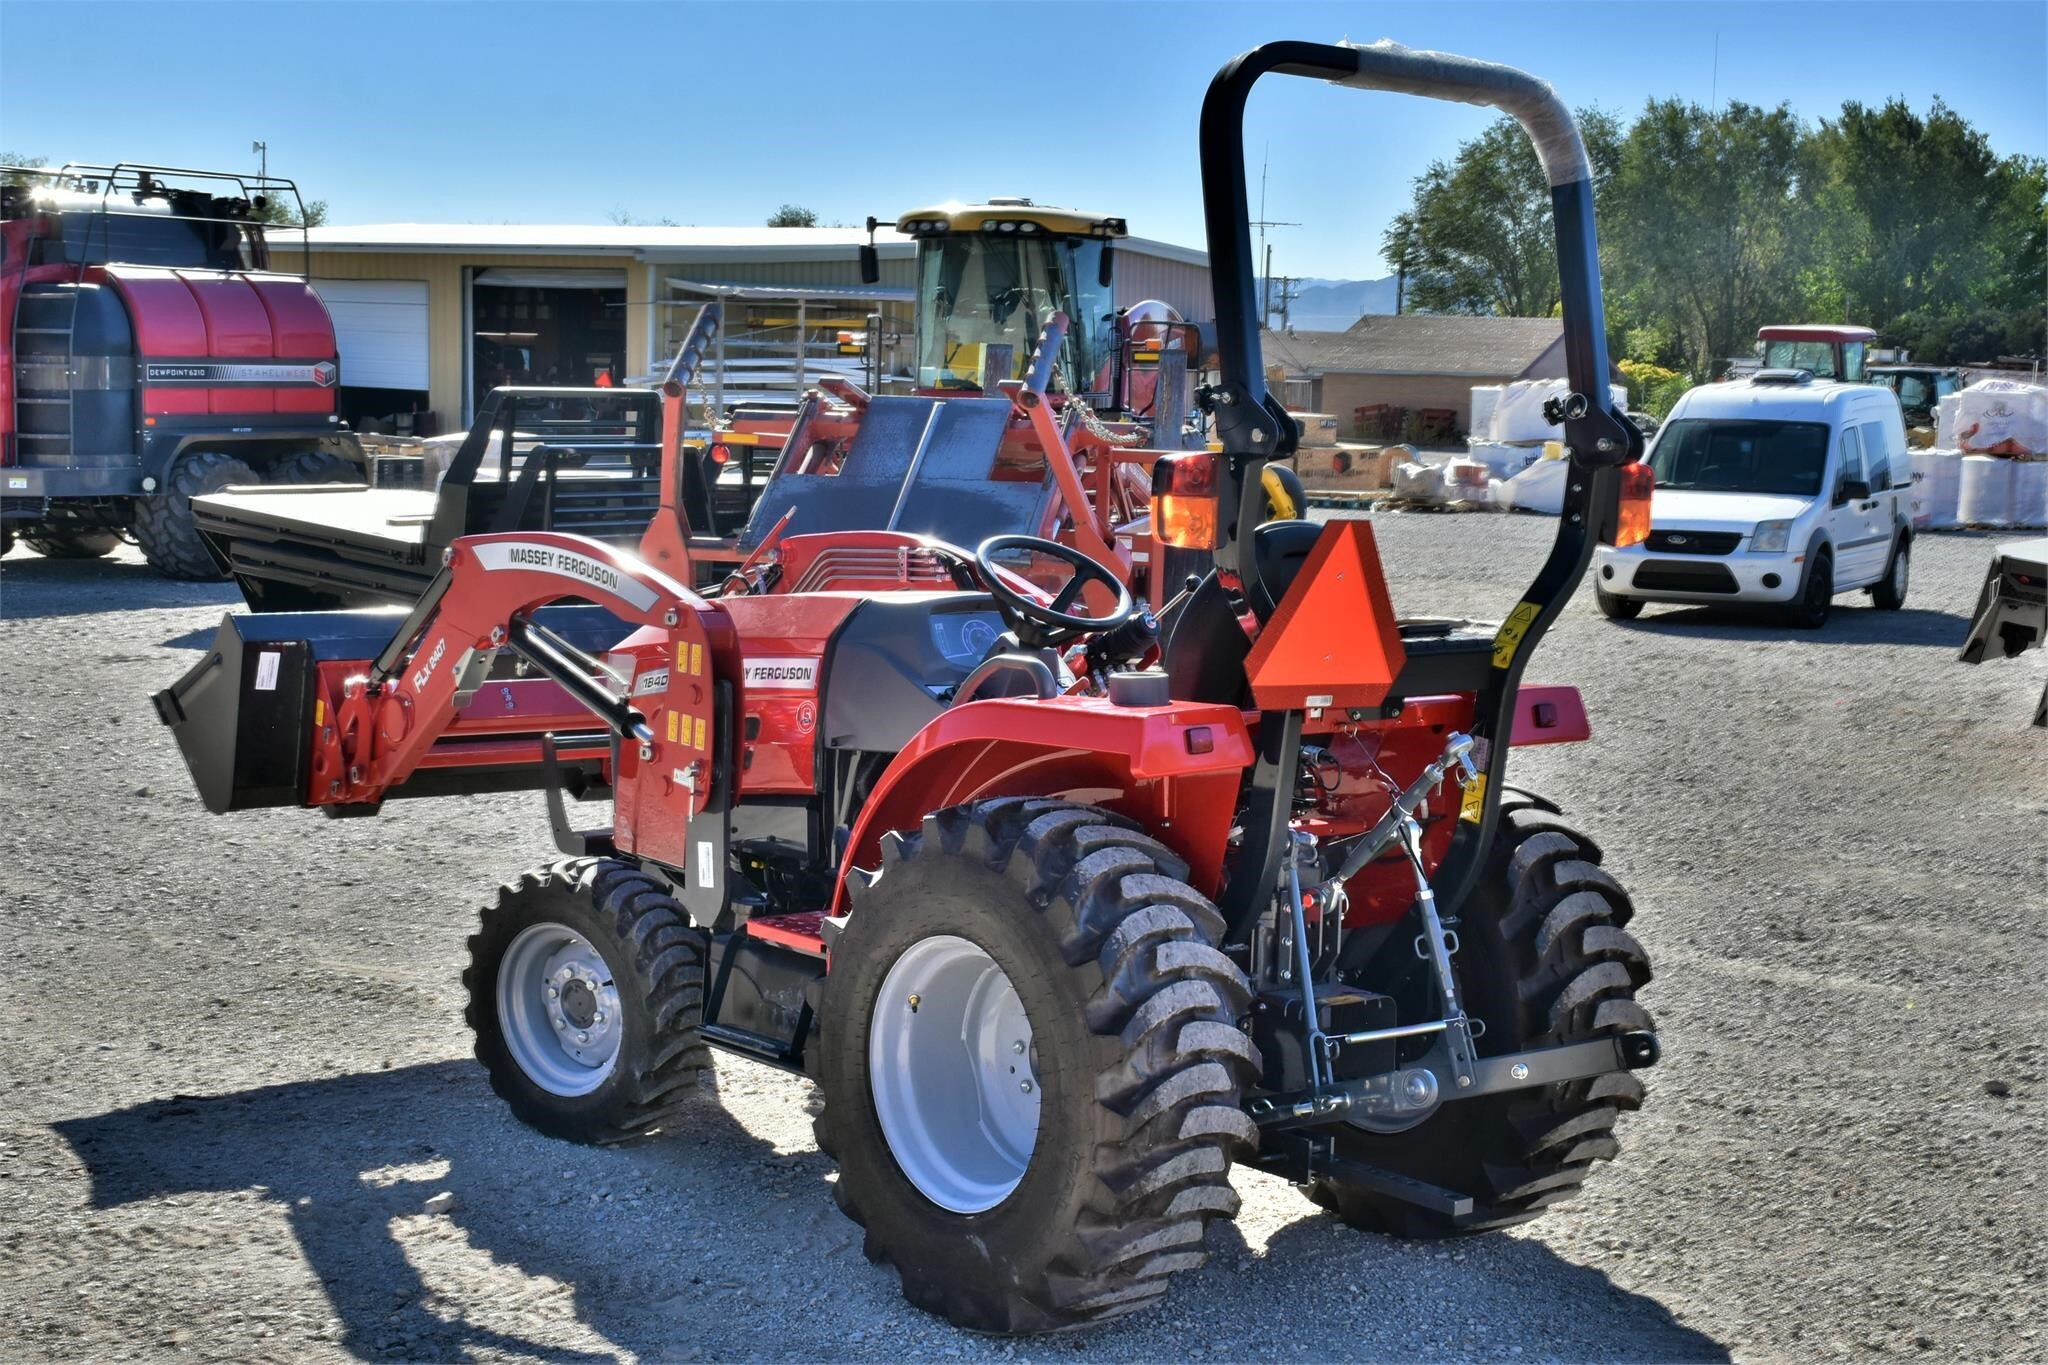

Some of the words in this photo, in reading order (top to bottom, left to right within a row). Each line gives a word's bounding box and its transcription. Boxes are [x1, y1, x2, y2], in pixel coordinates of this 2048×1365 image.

[510, 548, 555, 566] MASSEY
[558, 555, 619, 590] FERGUSON
[754, 666, 812, 680] FERGUSON
[643, 674, 669, 689] 1840
